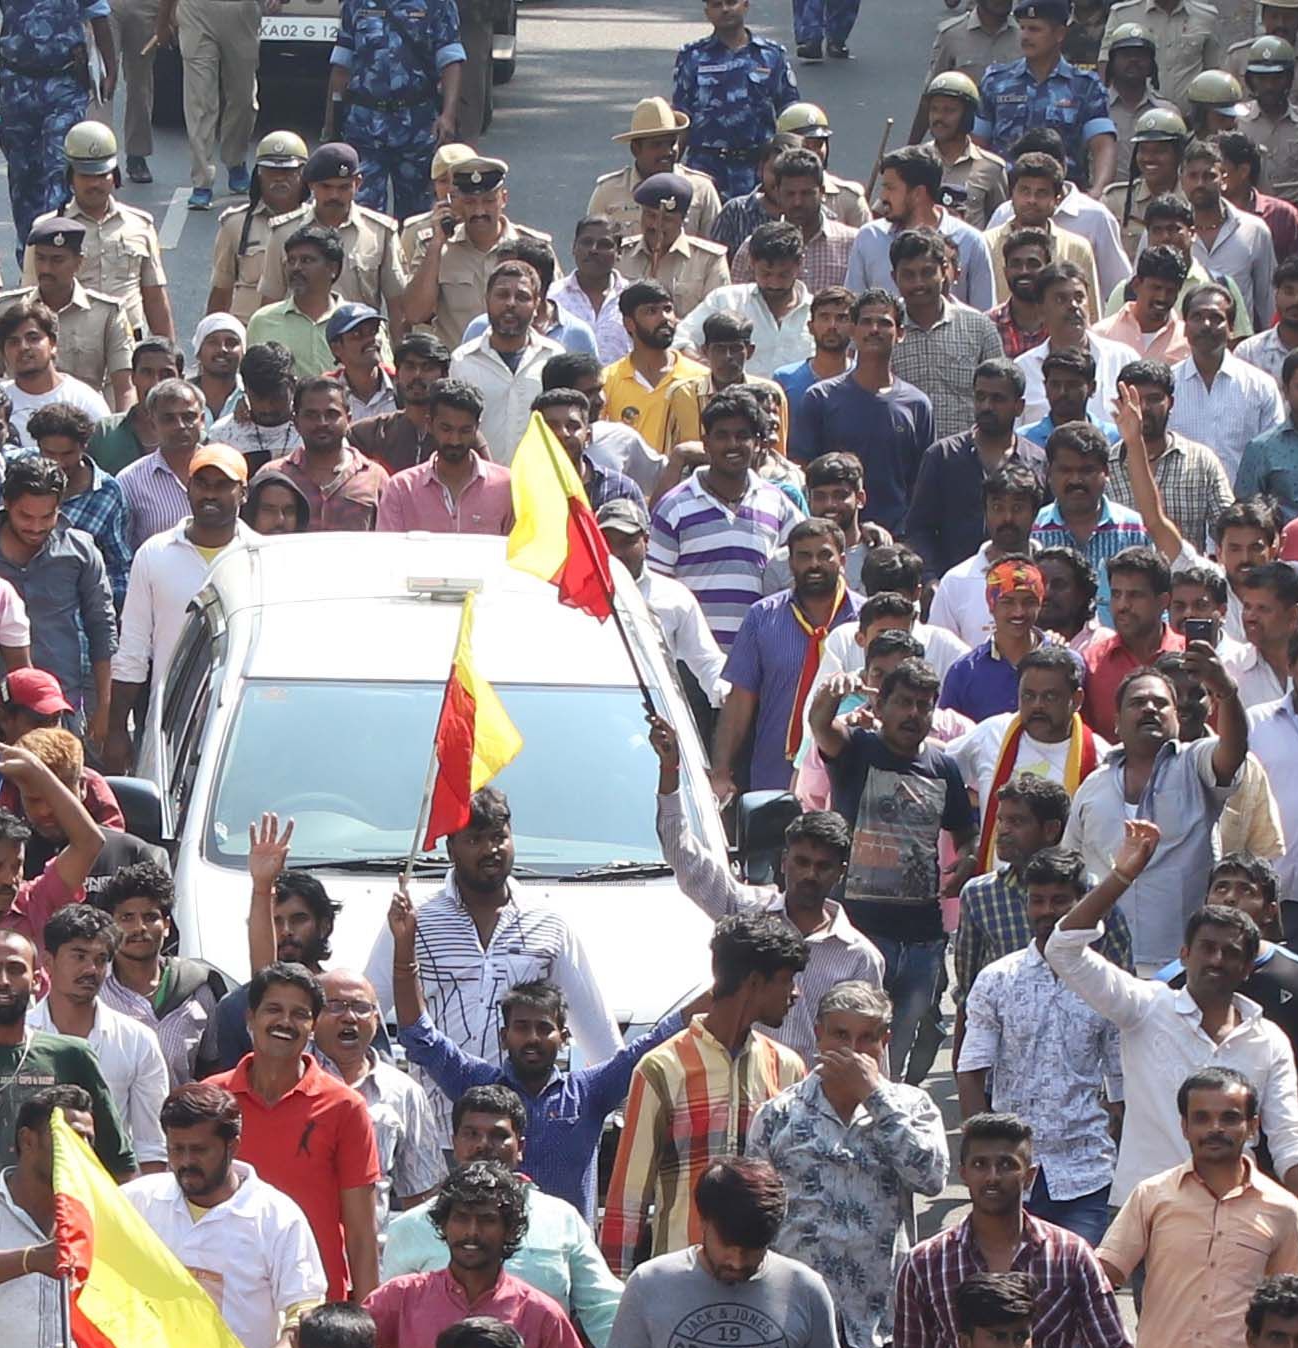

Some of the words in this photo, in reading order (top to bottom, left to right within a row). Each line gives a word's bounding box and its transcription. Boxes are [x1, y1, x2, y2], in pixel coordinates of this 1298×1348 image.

[303, 25, 315, 37] G
[684, 1311, 713, 1335] JACK
[720, 1308, 728, 1320] &
[733, 1308, 775, 1335] JONES
[718, 1326, 742, 1342] 19
